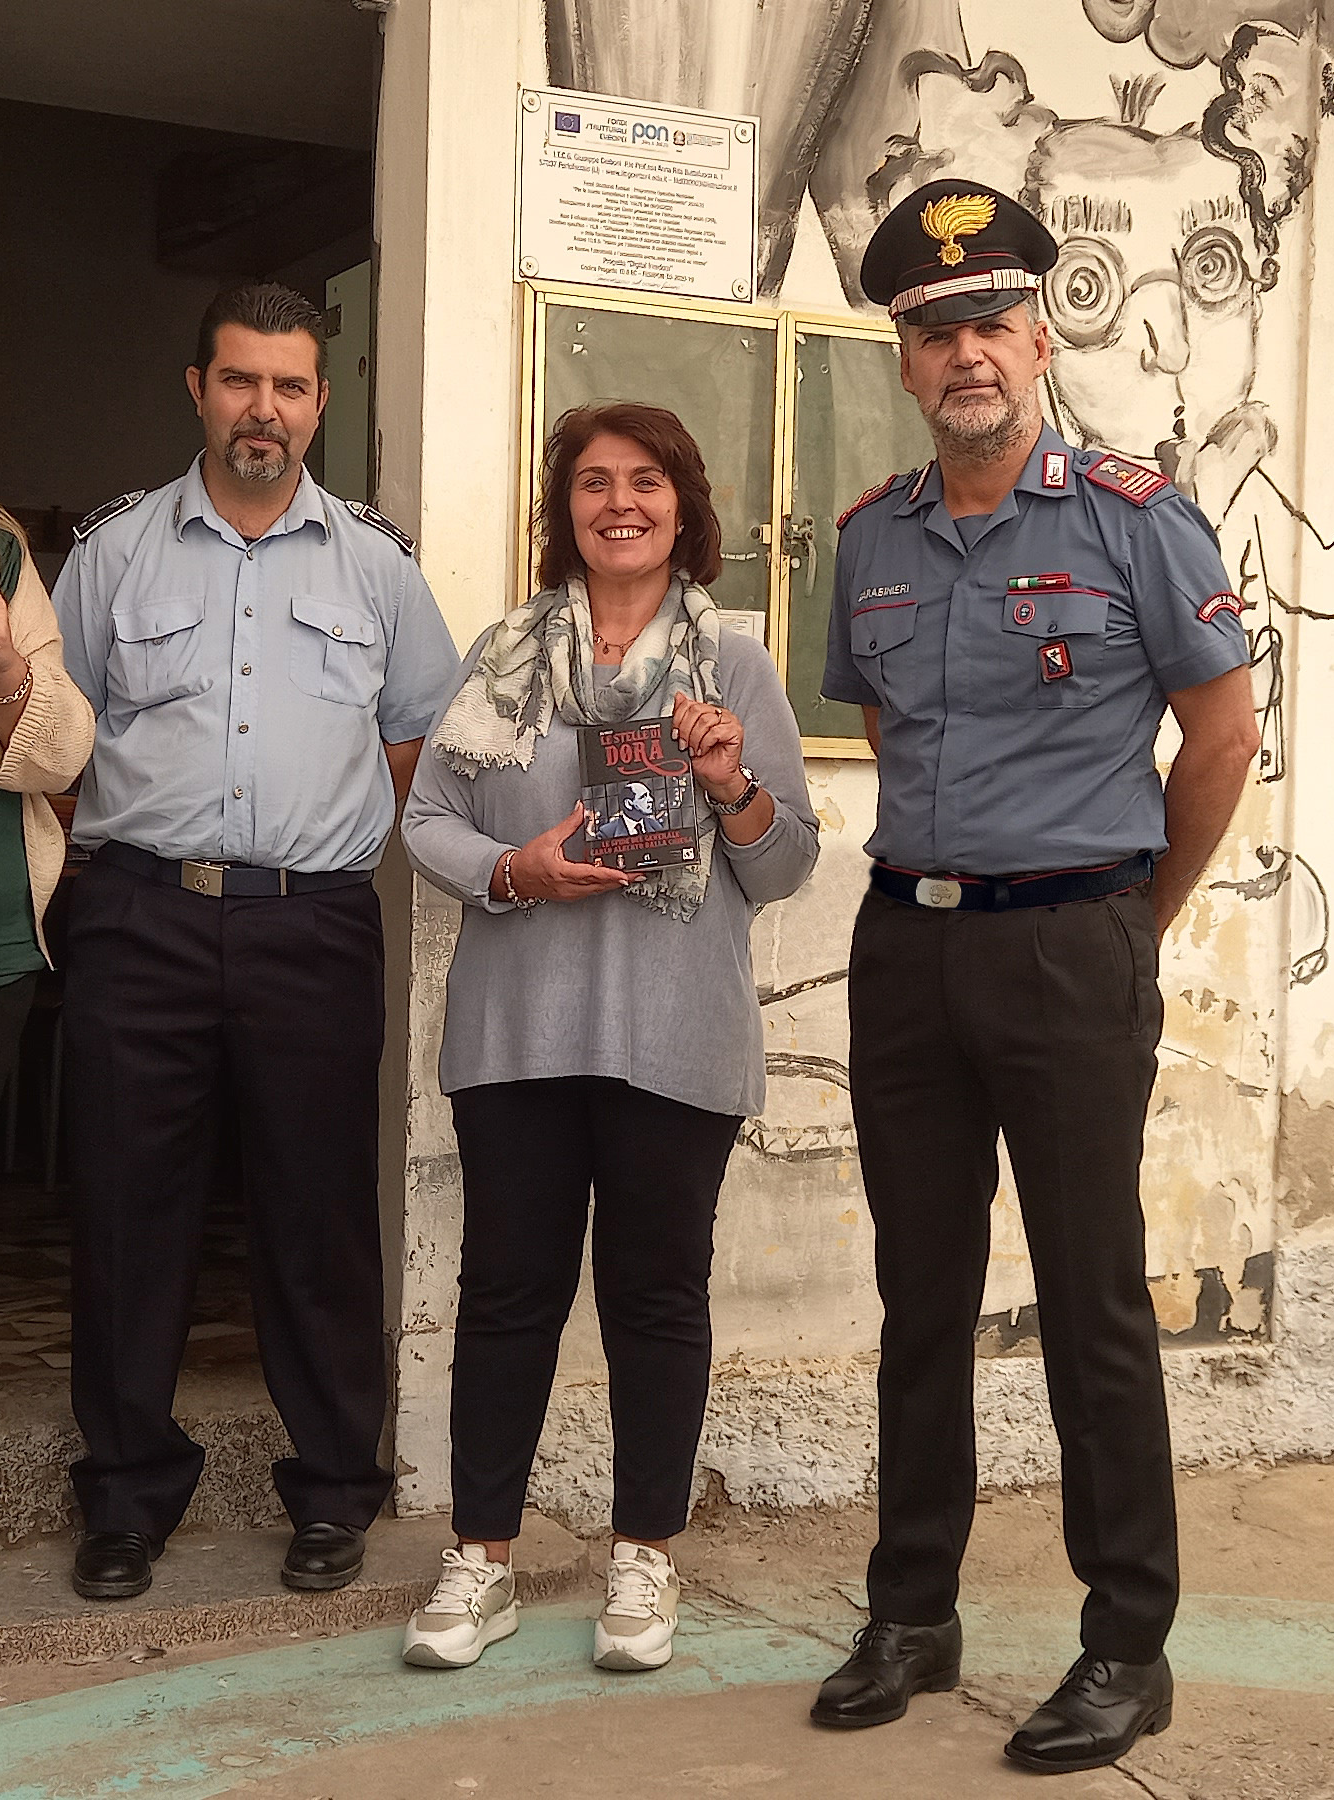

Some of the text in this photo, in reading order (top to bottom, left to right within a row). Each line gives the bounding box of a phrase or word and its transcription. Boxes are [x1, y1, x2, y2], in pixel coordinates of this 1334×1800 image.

[632, 122, 669, 144] pon
[601, 734, 613, 746] LE
[613, 730, 649, 743] STELLE
[650, 728, 661, 738] DI
[605, 739, 664, 767] DORA
